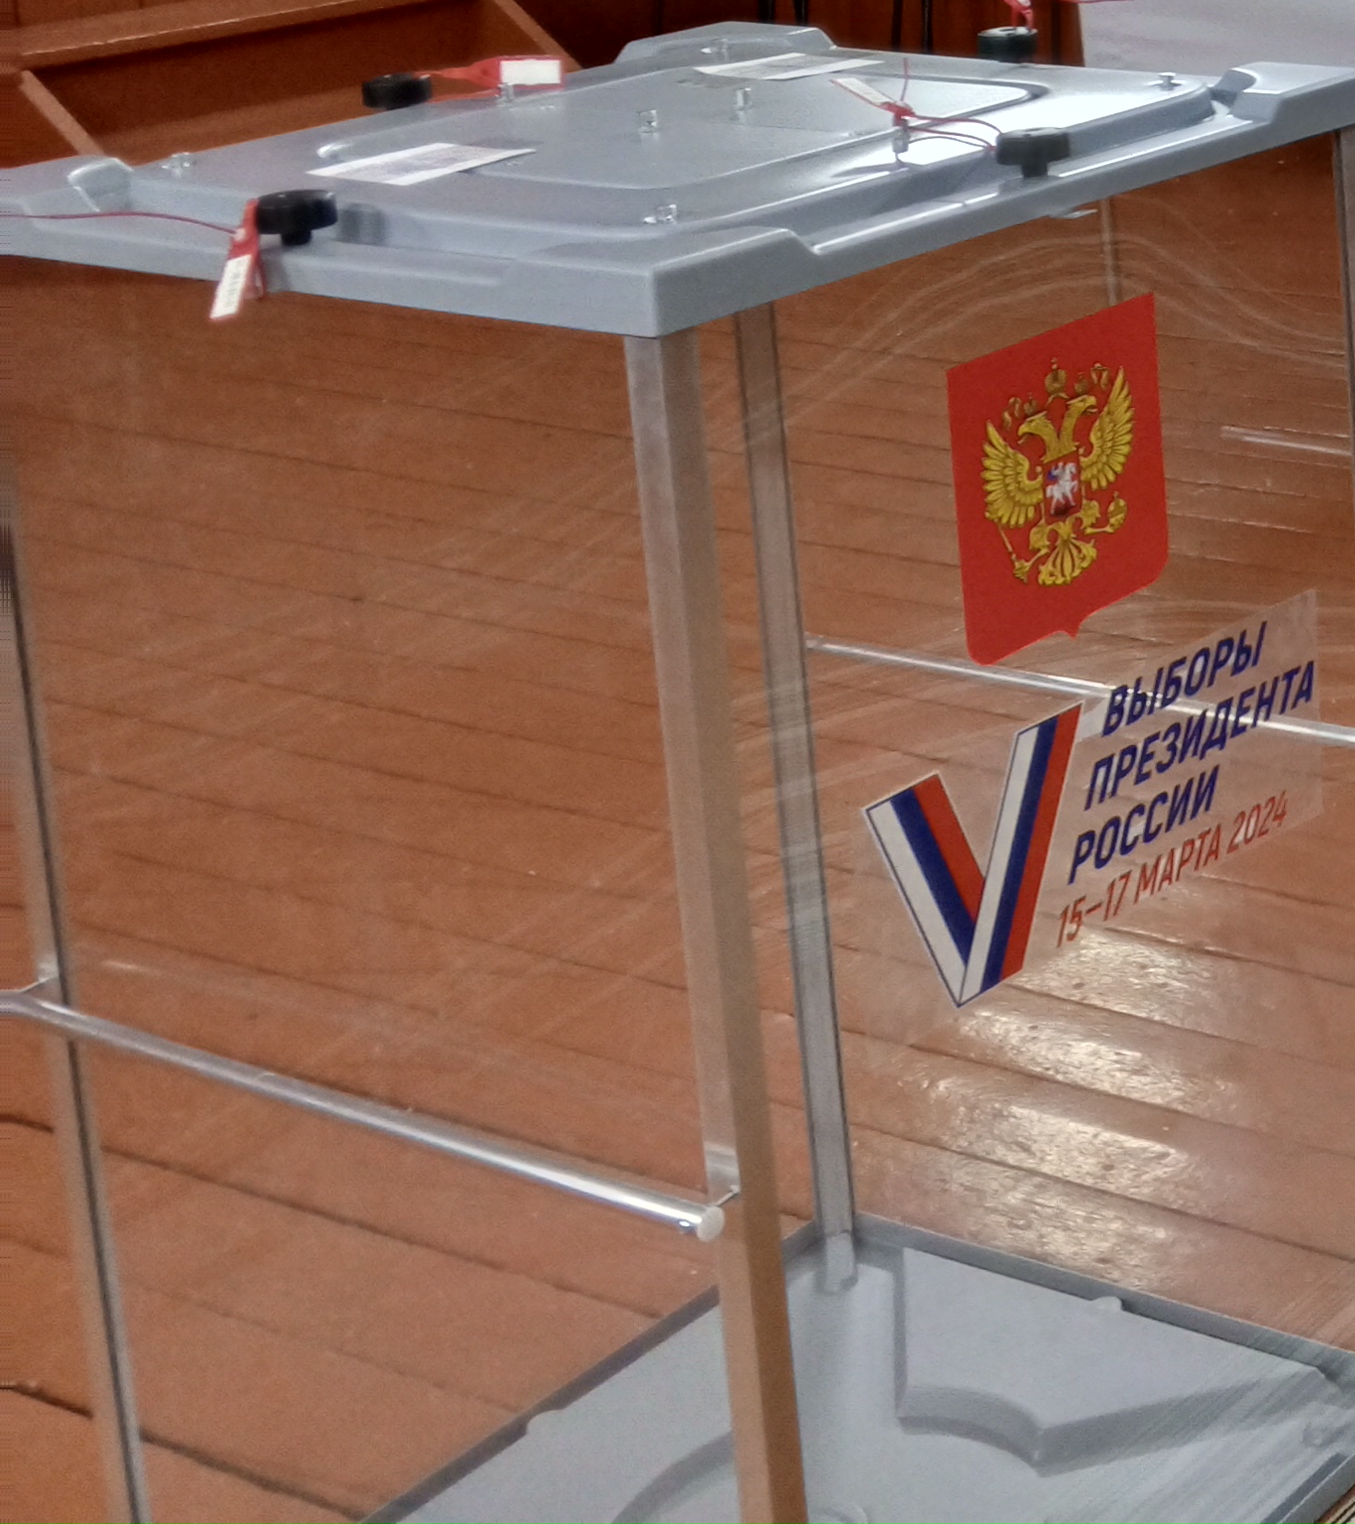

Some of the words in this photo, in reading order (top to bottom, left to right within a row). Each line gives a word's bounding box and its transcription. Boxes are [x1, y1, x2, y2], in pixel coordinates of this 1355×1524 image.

[1084, 660, 1315, 812] ПРЕЗИДЕНТА
[1101, 620, 1268, 738] ВЫБОРЫ
[1067, 764, 1220, 886] РОССИИ
[1133, 823, 1223, 905] МАРТА
[1226, 789, 1290, 855] 2024
